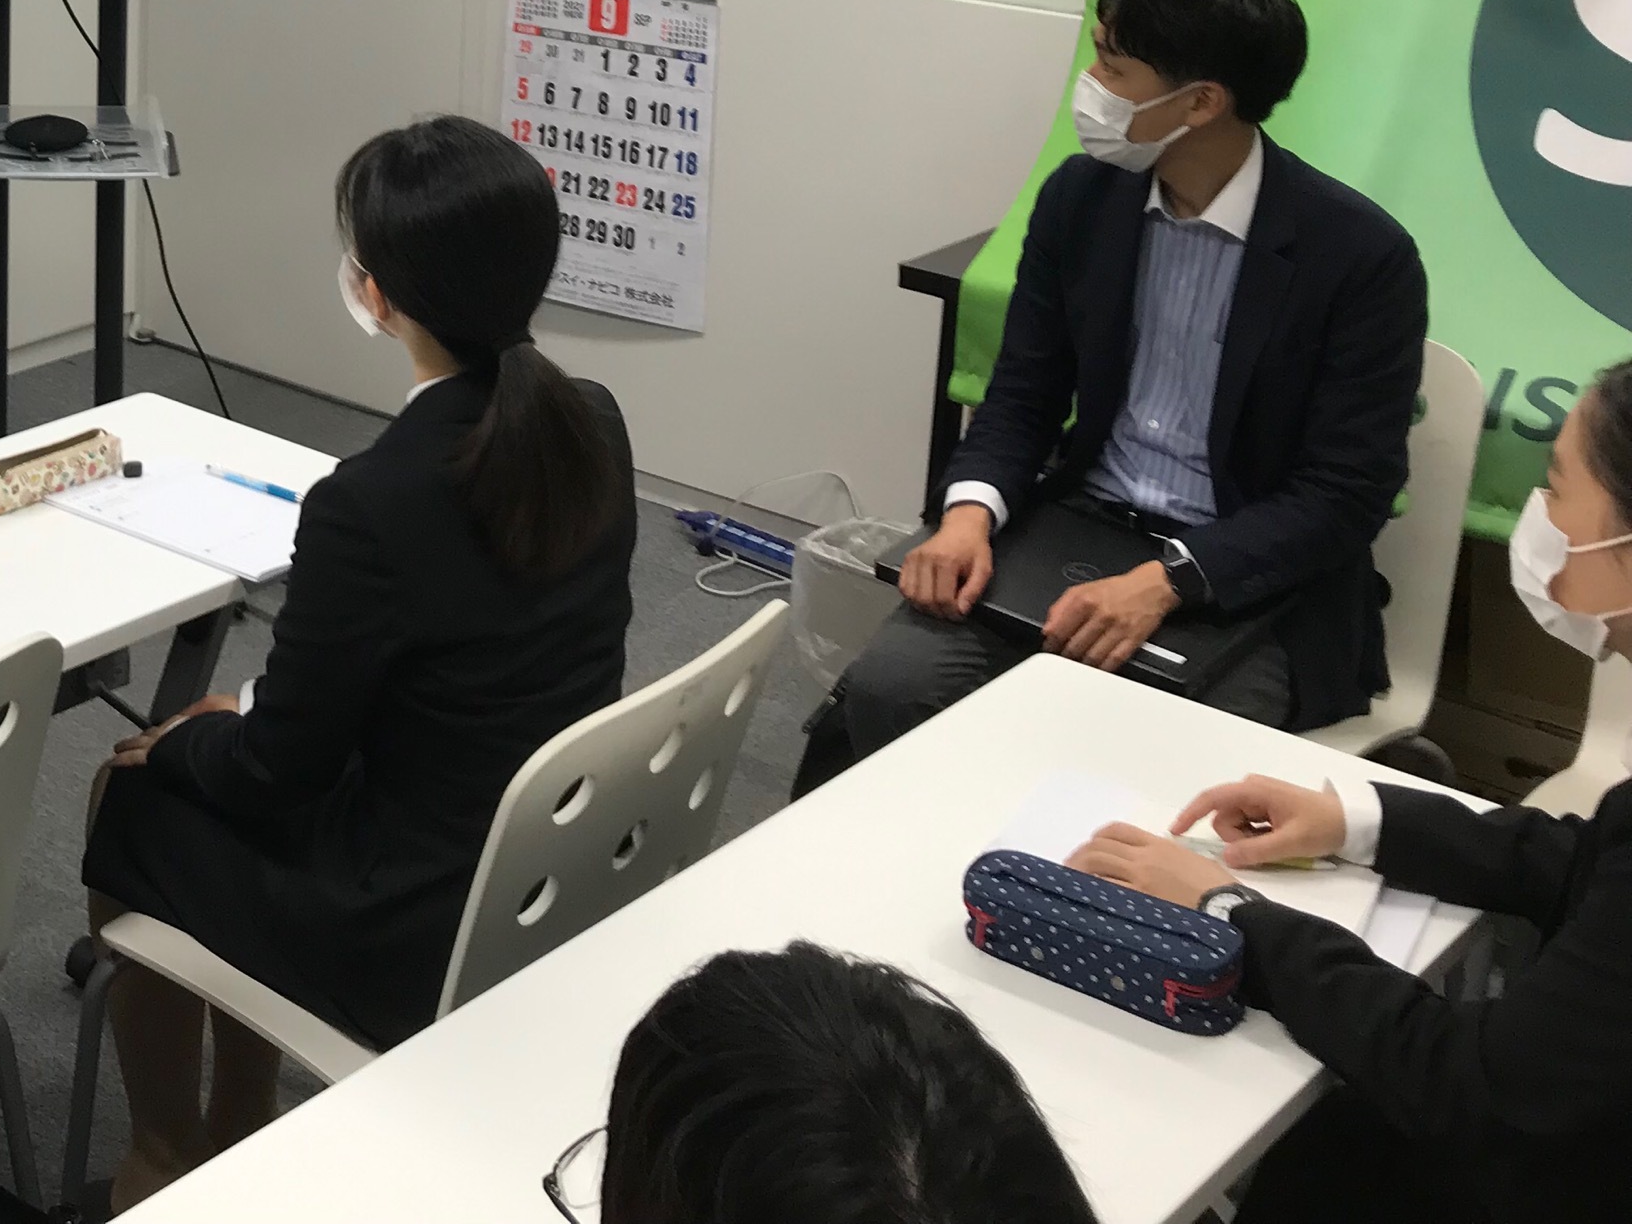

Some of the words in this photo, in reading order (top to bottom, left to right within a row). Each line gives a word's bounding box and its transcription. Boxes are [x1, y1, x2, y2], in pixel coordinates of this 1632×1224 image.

[601, 49, 610, 72] 1
[628, 54, 639, 77] 2
[655, 58, 667, 82] 3
[684, 63, 696, 86] 4
[518, 77, 529, 100] 5
[544, 82, 555, 105] 6
[571, 87, 582, 110] 7
[598, 92, 610, 115] 8
[625, 96, 637, 120] 9
[648, 101, 670, 126] 10
[677, 106, 698, 132] 11
[511, 118, 532, 143] 12
[537, 123, 558, 148] 13
[563, 128, 585, 154] 14
[591, 133, 612, 159] 15
[618, 139, 640, 164] 16
[646, 144, 669, 170] 17
[674, 150, 698, 175] 18
[560, 170, 581, 196] 21
[588, 176, 610, 202] 22
[615, 181, 638, 207] 23
[643, 187, 666, 213] 24
[671, 193, 696, 219] 25
[559, 213, 580, 238] 28
[585, 218, 608, 244] 29
[613, 223, 636, 250] 30
